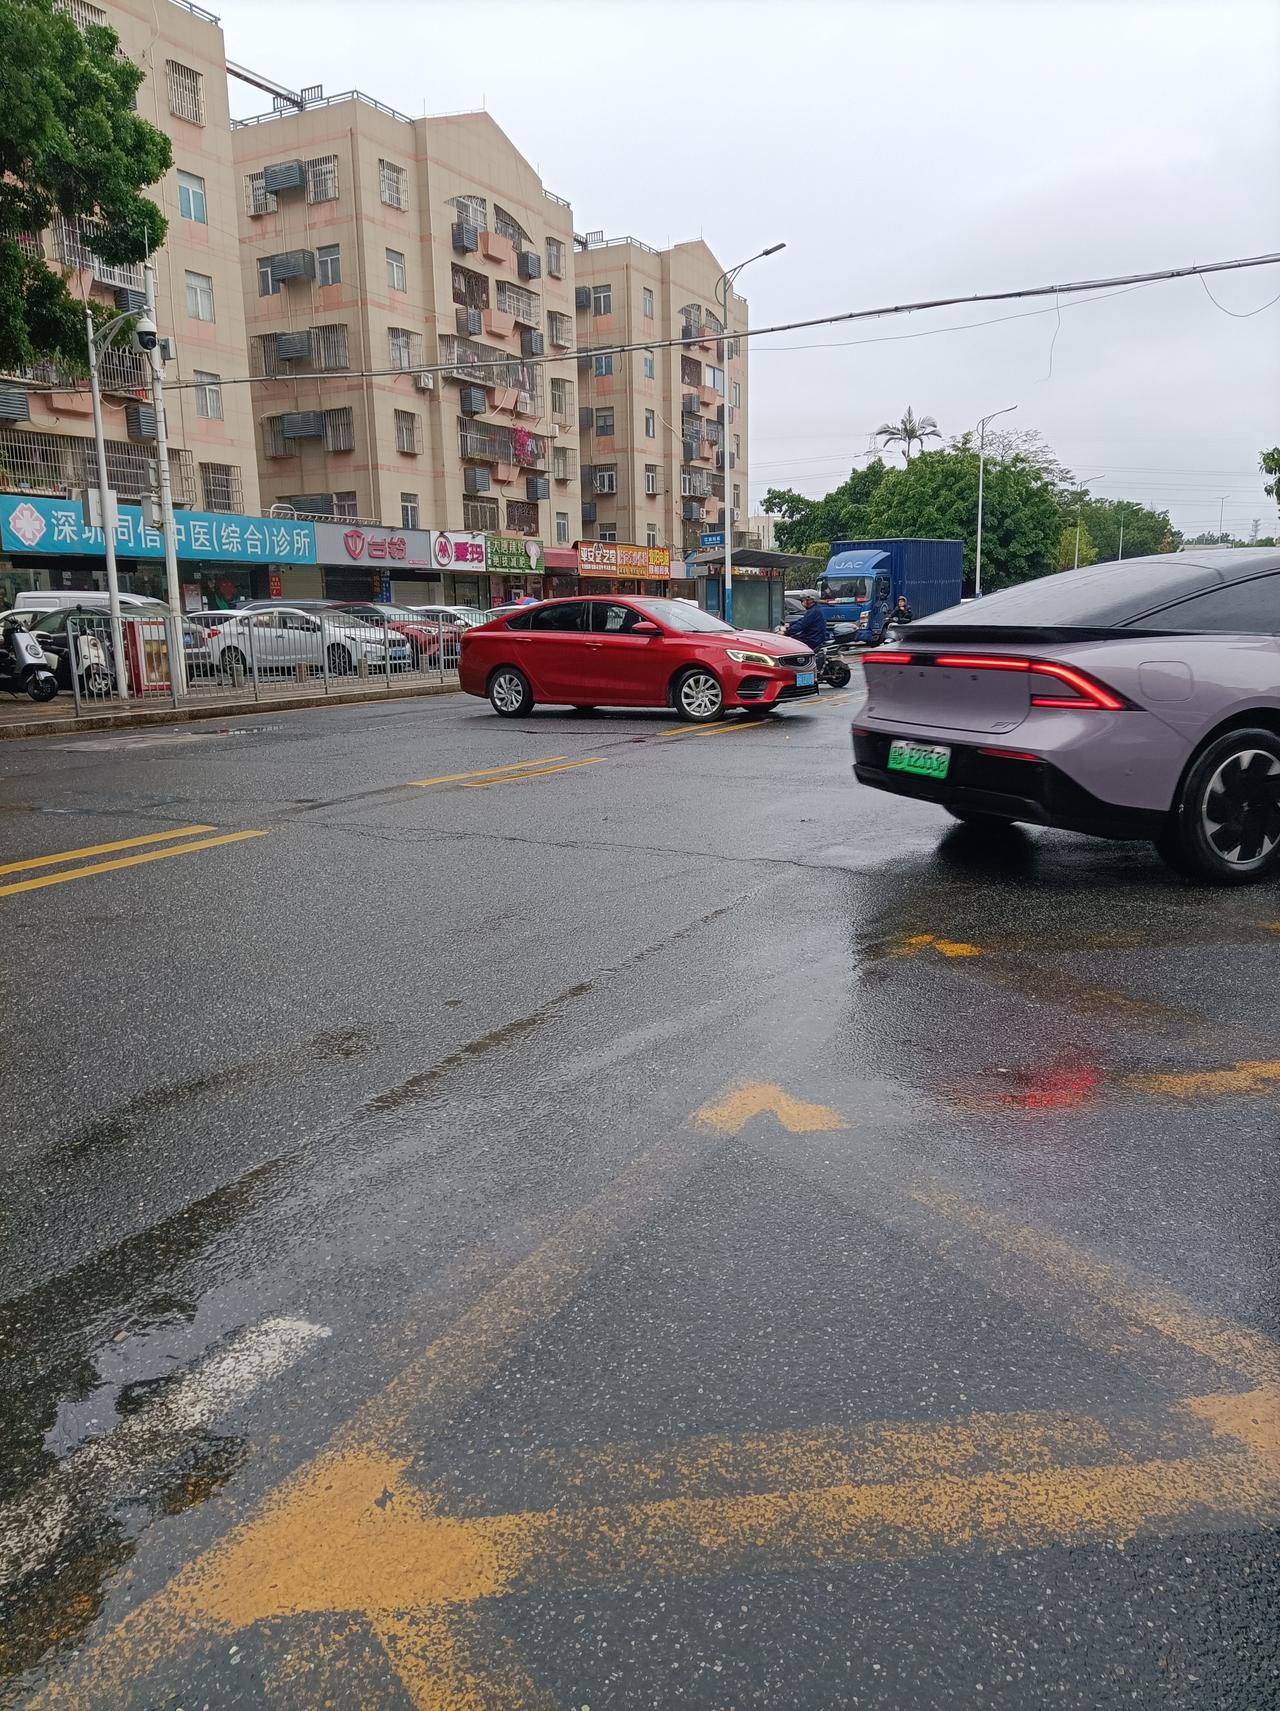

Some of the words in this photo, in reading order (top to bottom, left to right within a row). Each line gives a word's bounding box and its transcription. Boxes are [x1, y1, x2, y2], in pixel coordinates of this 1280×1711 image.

[368, 535, 407, 560] 台铃
[454, 542, 485, 563] 爱玛
[836, 561, 864, 569] JAC
